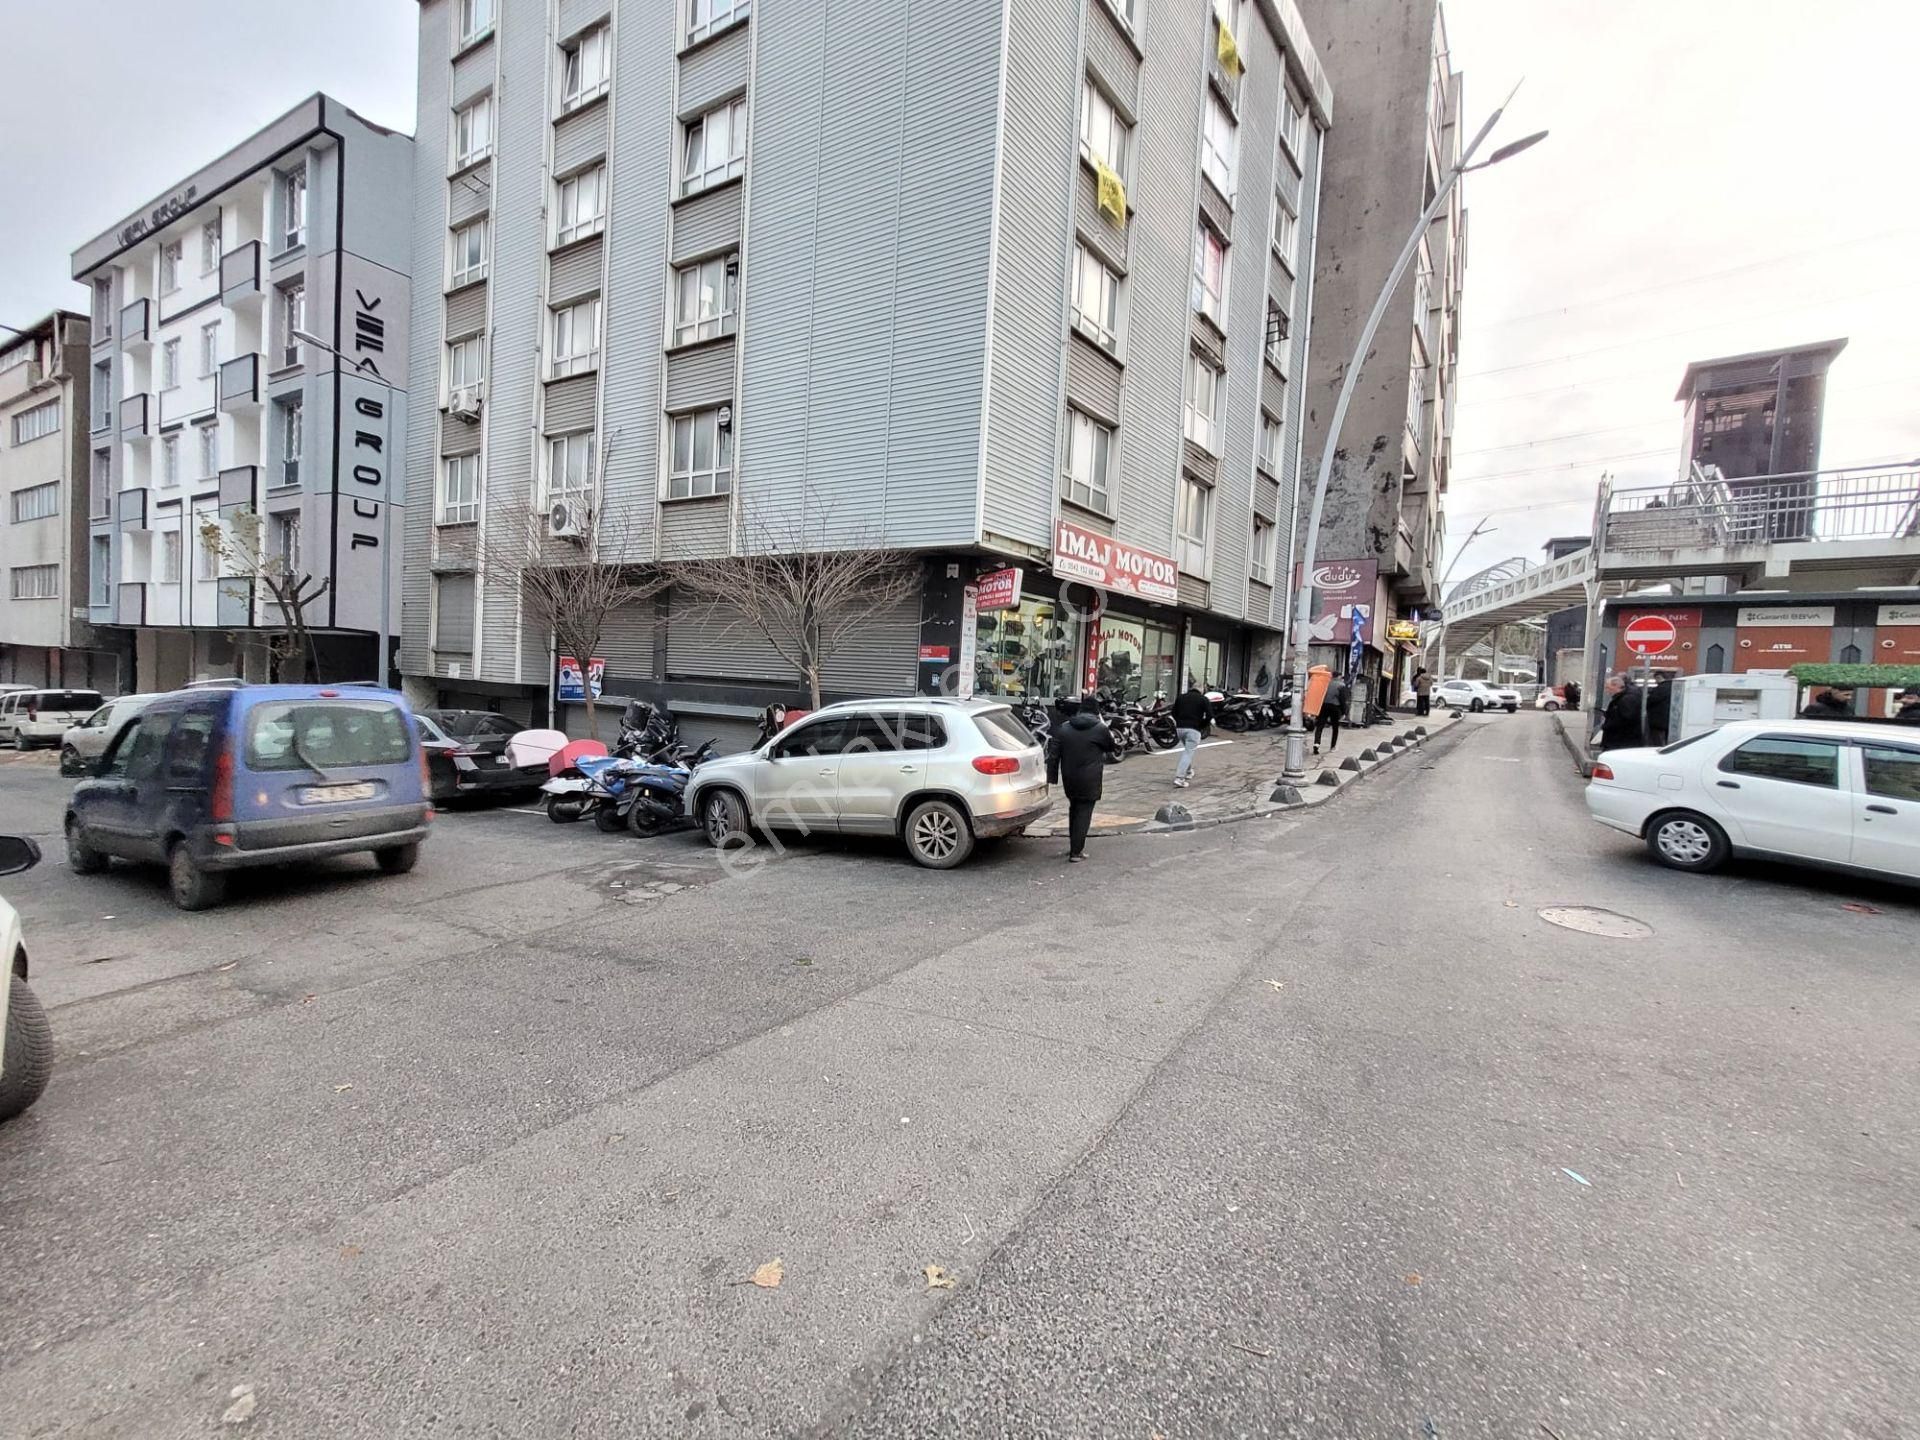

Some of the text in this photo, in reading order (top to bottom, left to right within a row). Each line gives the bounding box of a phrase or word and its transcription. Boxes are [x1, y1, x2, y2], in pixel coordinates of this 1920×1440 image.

[152, 184, 198, 227] GROUP
[351, 397, 384, 551] GROUP
[1059, 523, 1176, 585] İMAJ MOTOR
[978, 579, 1012, 595] MOTOR
[1324, 569, 1352, 581] dudu
[1756, 612, 1821, 621] Garanti BBVA
